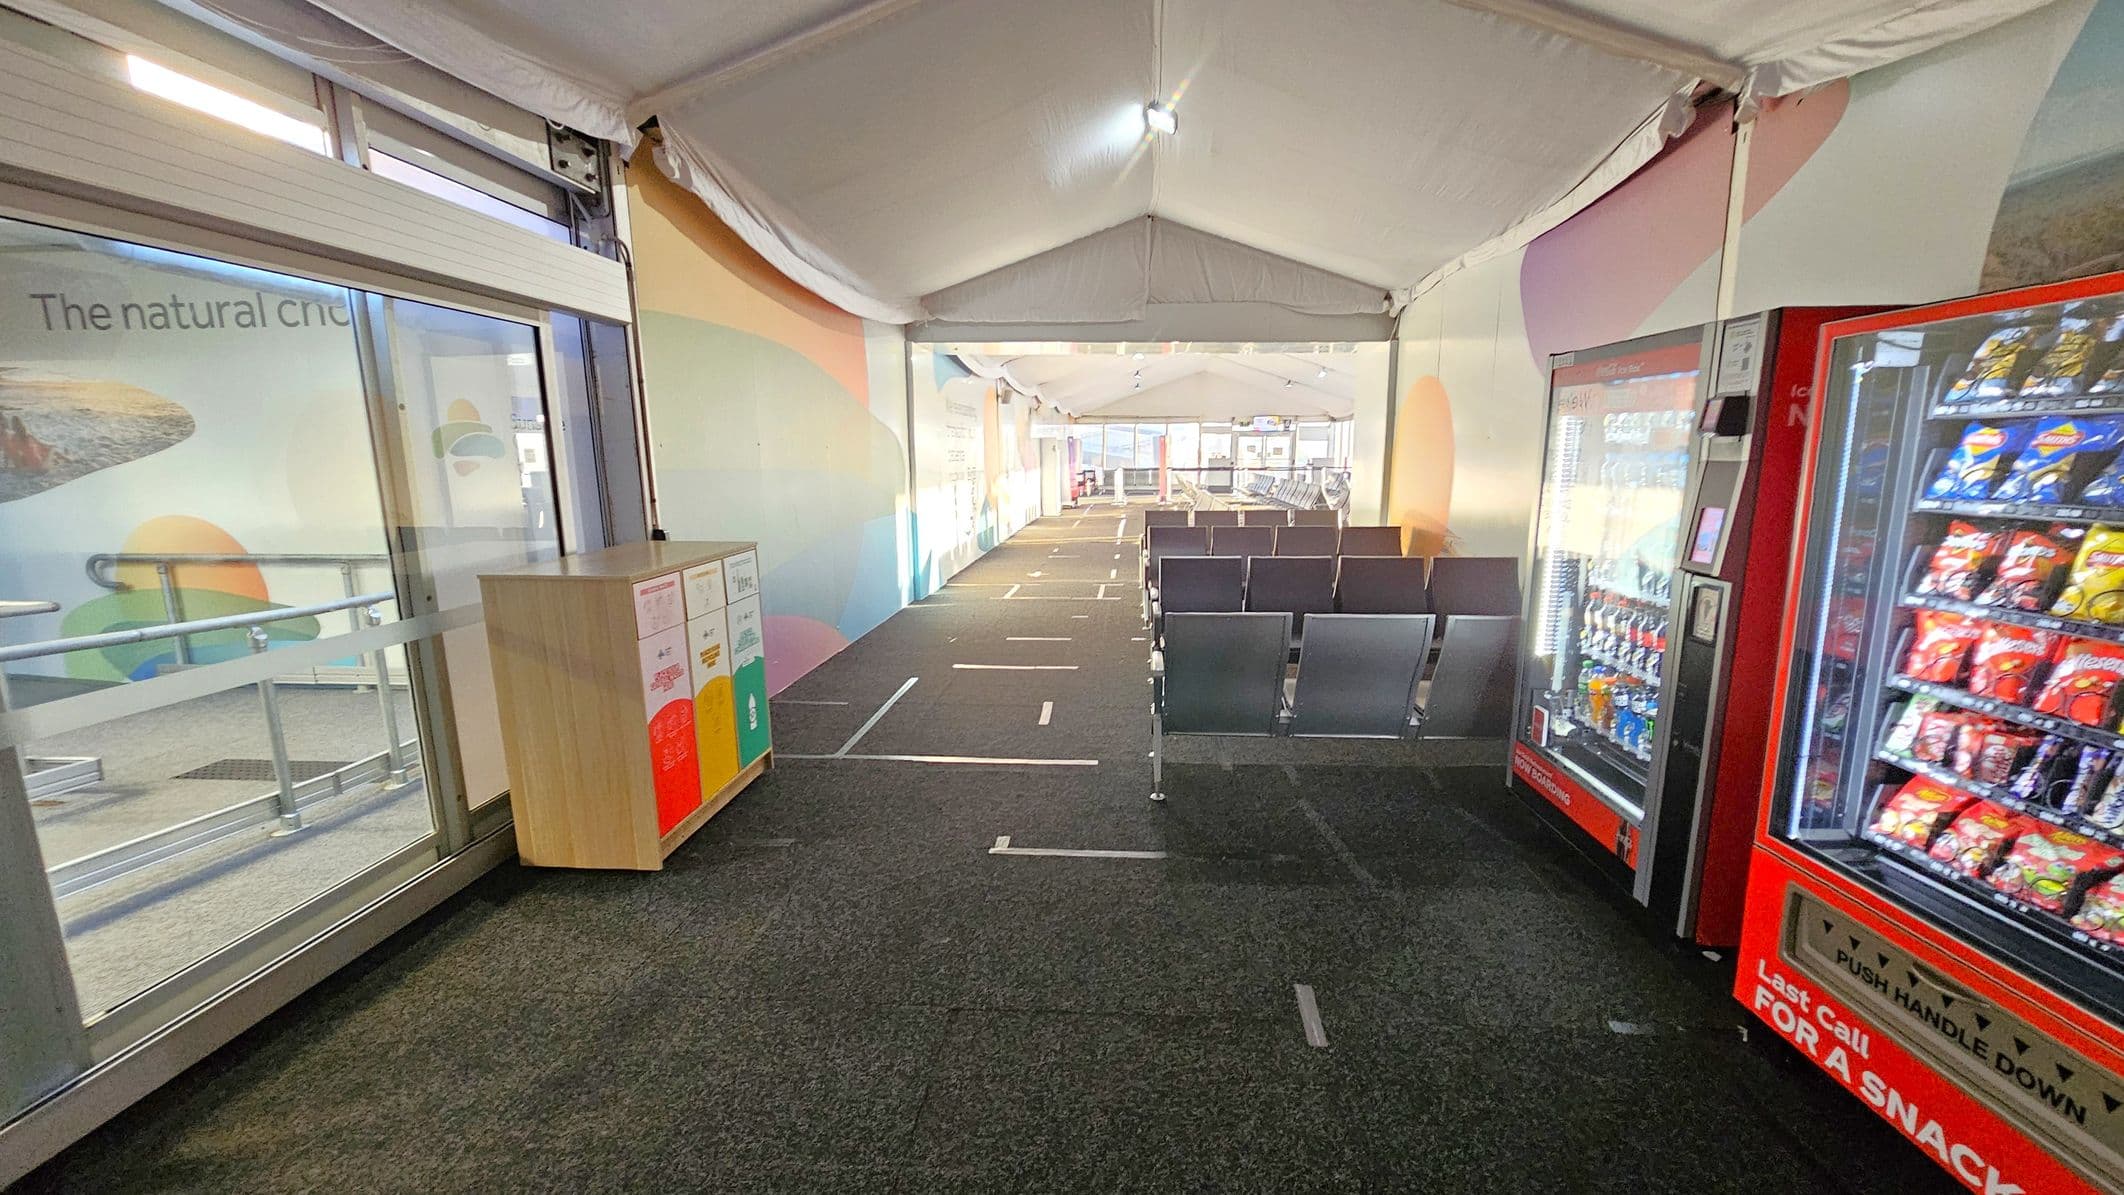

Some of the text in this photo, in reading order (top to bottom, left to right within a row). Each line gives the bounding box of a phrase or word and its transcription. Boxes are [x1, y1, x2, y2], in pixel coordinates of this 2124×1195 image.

[30, 293, 112, 331] The
[121, 292, 267, 330] natural
[1515, 754, 1532, 774] NOW
[1532, 767, 1571, 806] BOARDING
[1754, 984, 1819, 1057] FOR
[1824, 1046, 1851, 1084] A
[1758, 958, 1870, 1060] Last Call
[1836, 949, 2087, 1125] PUSH HANDLE DOWN
